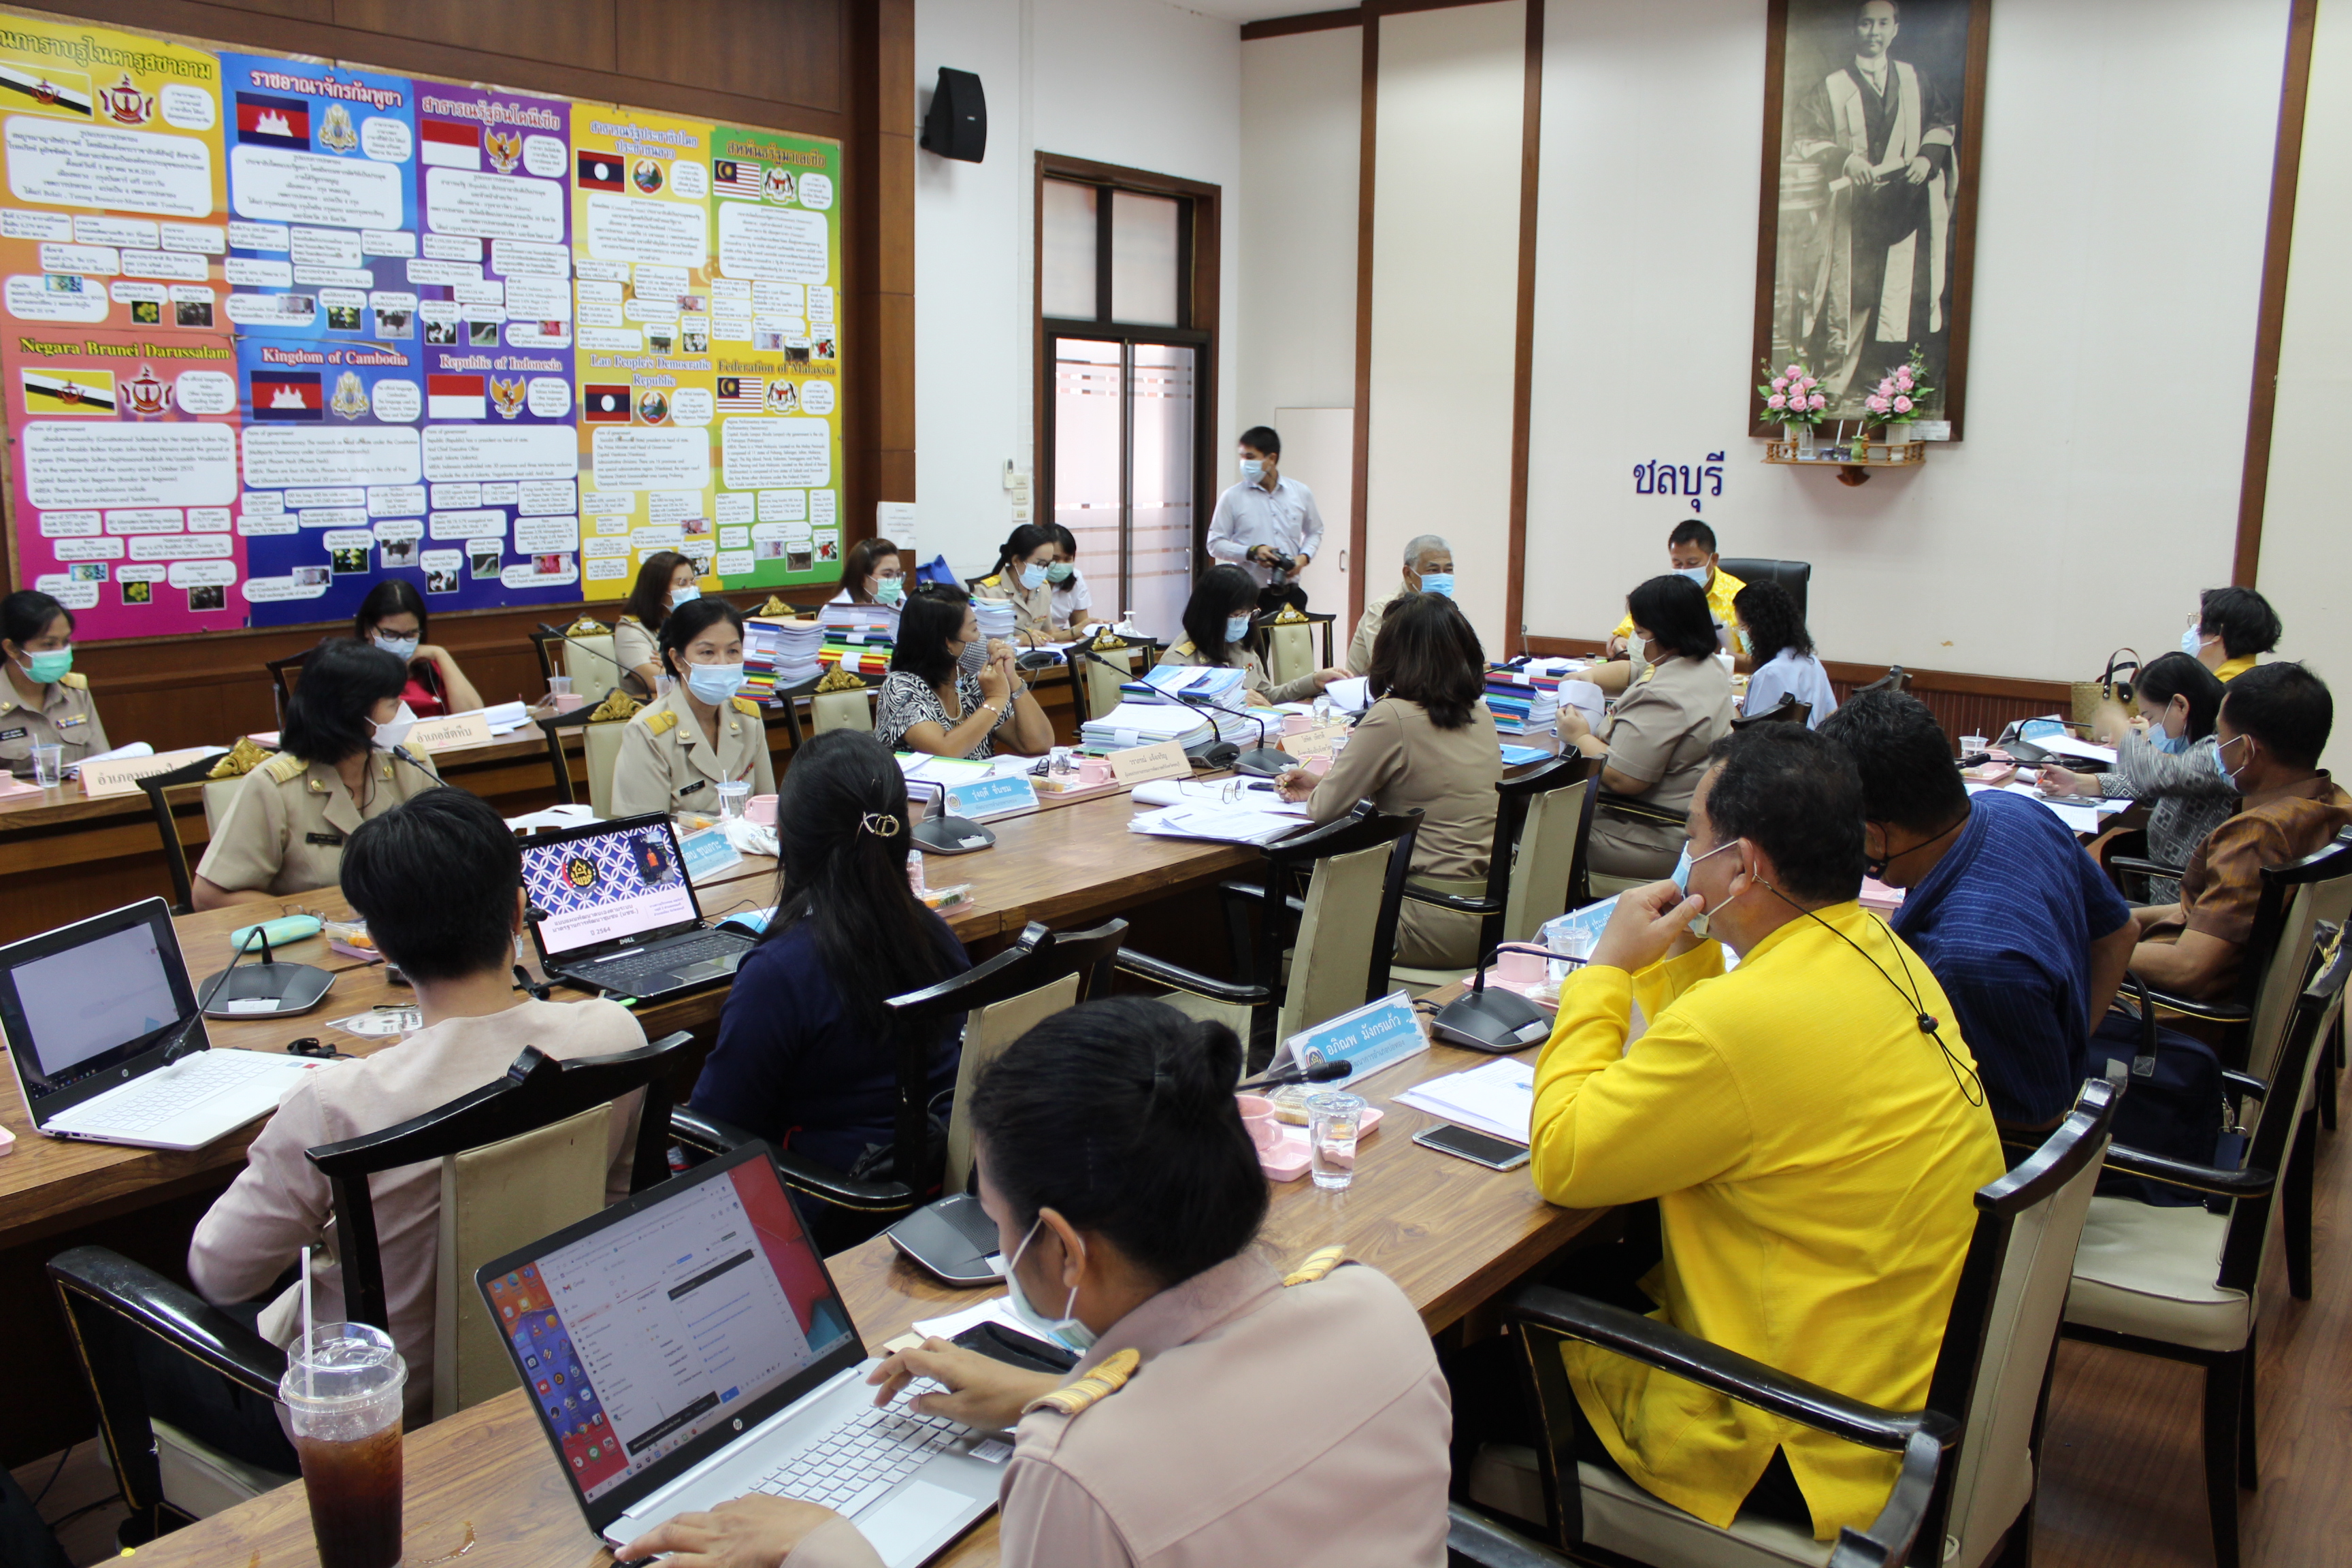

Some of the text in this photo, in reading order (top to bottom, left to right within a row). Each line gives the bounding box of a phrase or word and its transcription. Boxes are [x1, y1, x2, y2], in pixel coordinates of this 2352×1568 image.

[250, 70, 403, 110] ราชอาณาจักรกัมพูชา
[422, 96, 561, 131] สาธารณรัฐอินโดนีเซีย
[590, 120, 699, 148] สาธารณรัฐประชาธิปไตย
[615, 139, 676, 160] ประชาชนลาว
[726, 140, 826, 168] สหพันธรัฐมาเลเซีย
[19, 338, 230, 360] Negara Brunei Darussalam
[261, 348, 409, 366] Kingdom of Cambodia
[440, 354, 563, 372] Republic of Indonesia
[590, 355, 711, 371] Lao People's Democratic
[717, 359, 836, 378] Federation of Malaysia
[632, 374, 676, 388] Republic
[1633, 450, 1725, 513] ชลบุรี
[416, 724, 472, 743] อำเภอสัตหีบ
[597, 926, 612, 935] 2564
[1360, 1012, 1402, 1041] มังกรแก้ว
[1351, 1039, 1406, 1069] ัฒนาการอำเภอบ่อทอง
[733, 1418, 742, 1431] hp
